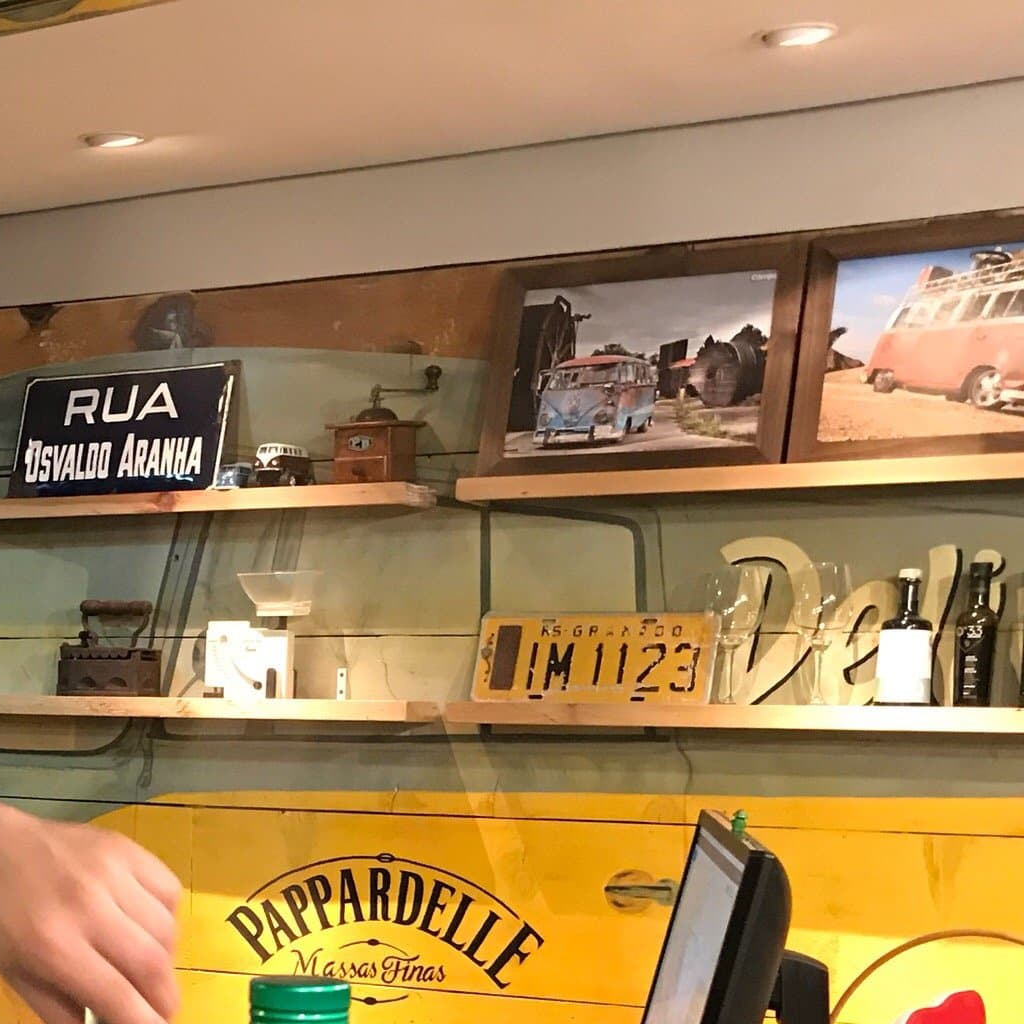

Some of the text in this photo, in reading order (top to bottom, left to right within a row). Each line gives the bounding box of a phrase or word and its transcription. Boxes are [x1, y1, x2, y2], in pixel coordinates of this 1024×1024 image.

[63, 382, 179, 426] RUA
[117, 433, 203, 478] ARANHA
[592, 642, 701, 693] 1123
[225, 867, 545, 990] PAPPARDELLE
[291, 948, 447, 984] Massas Finas
